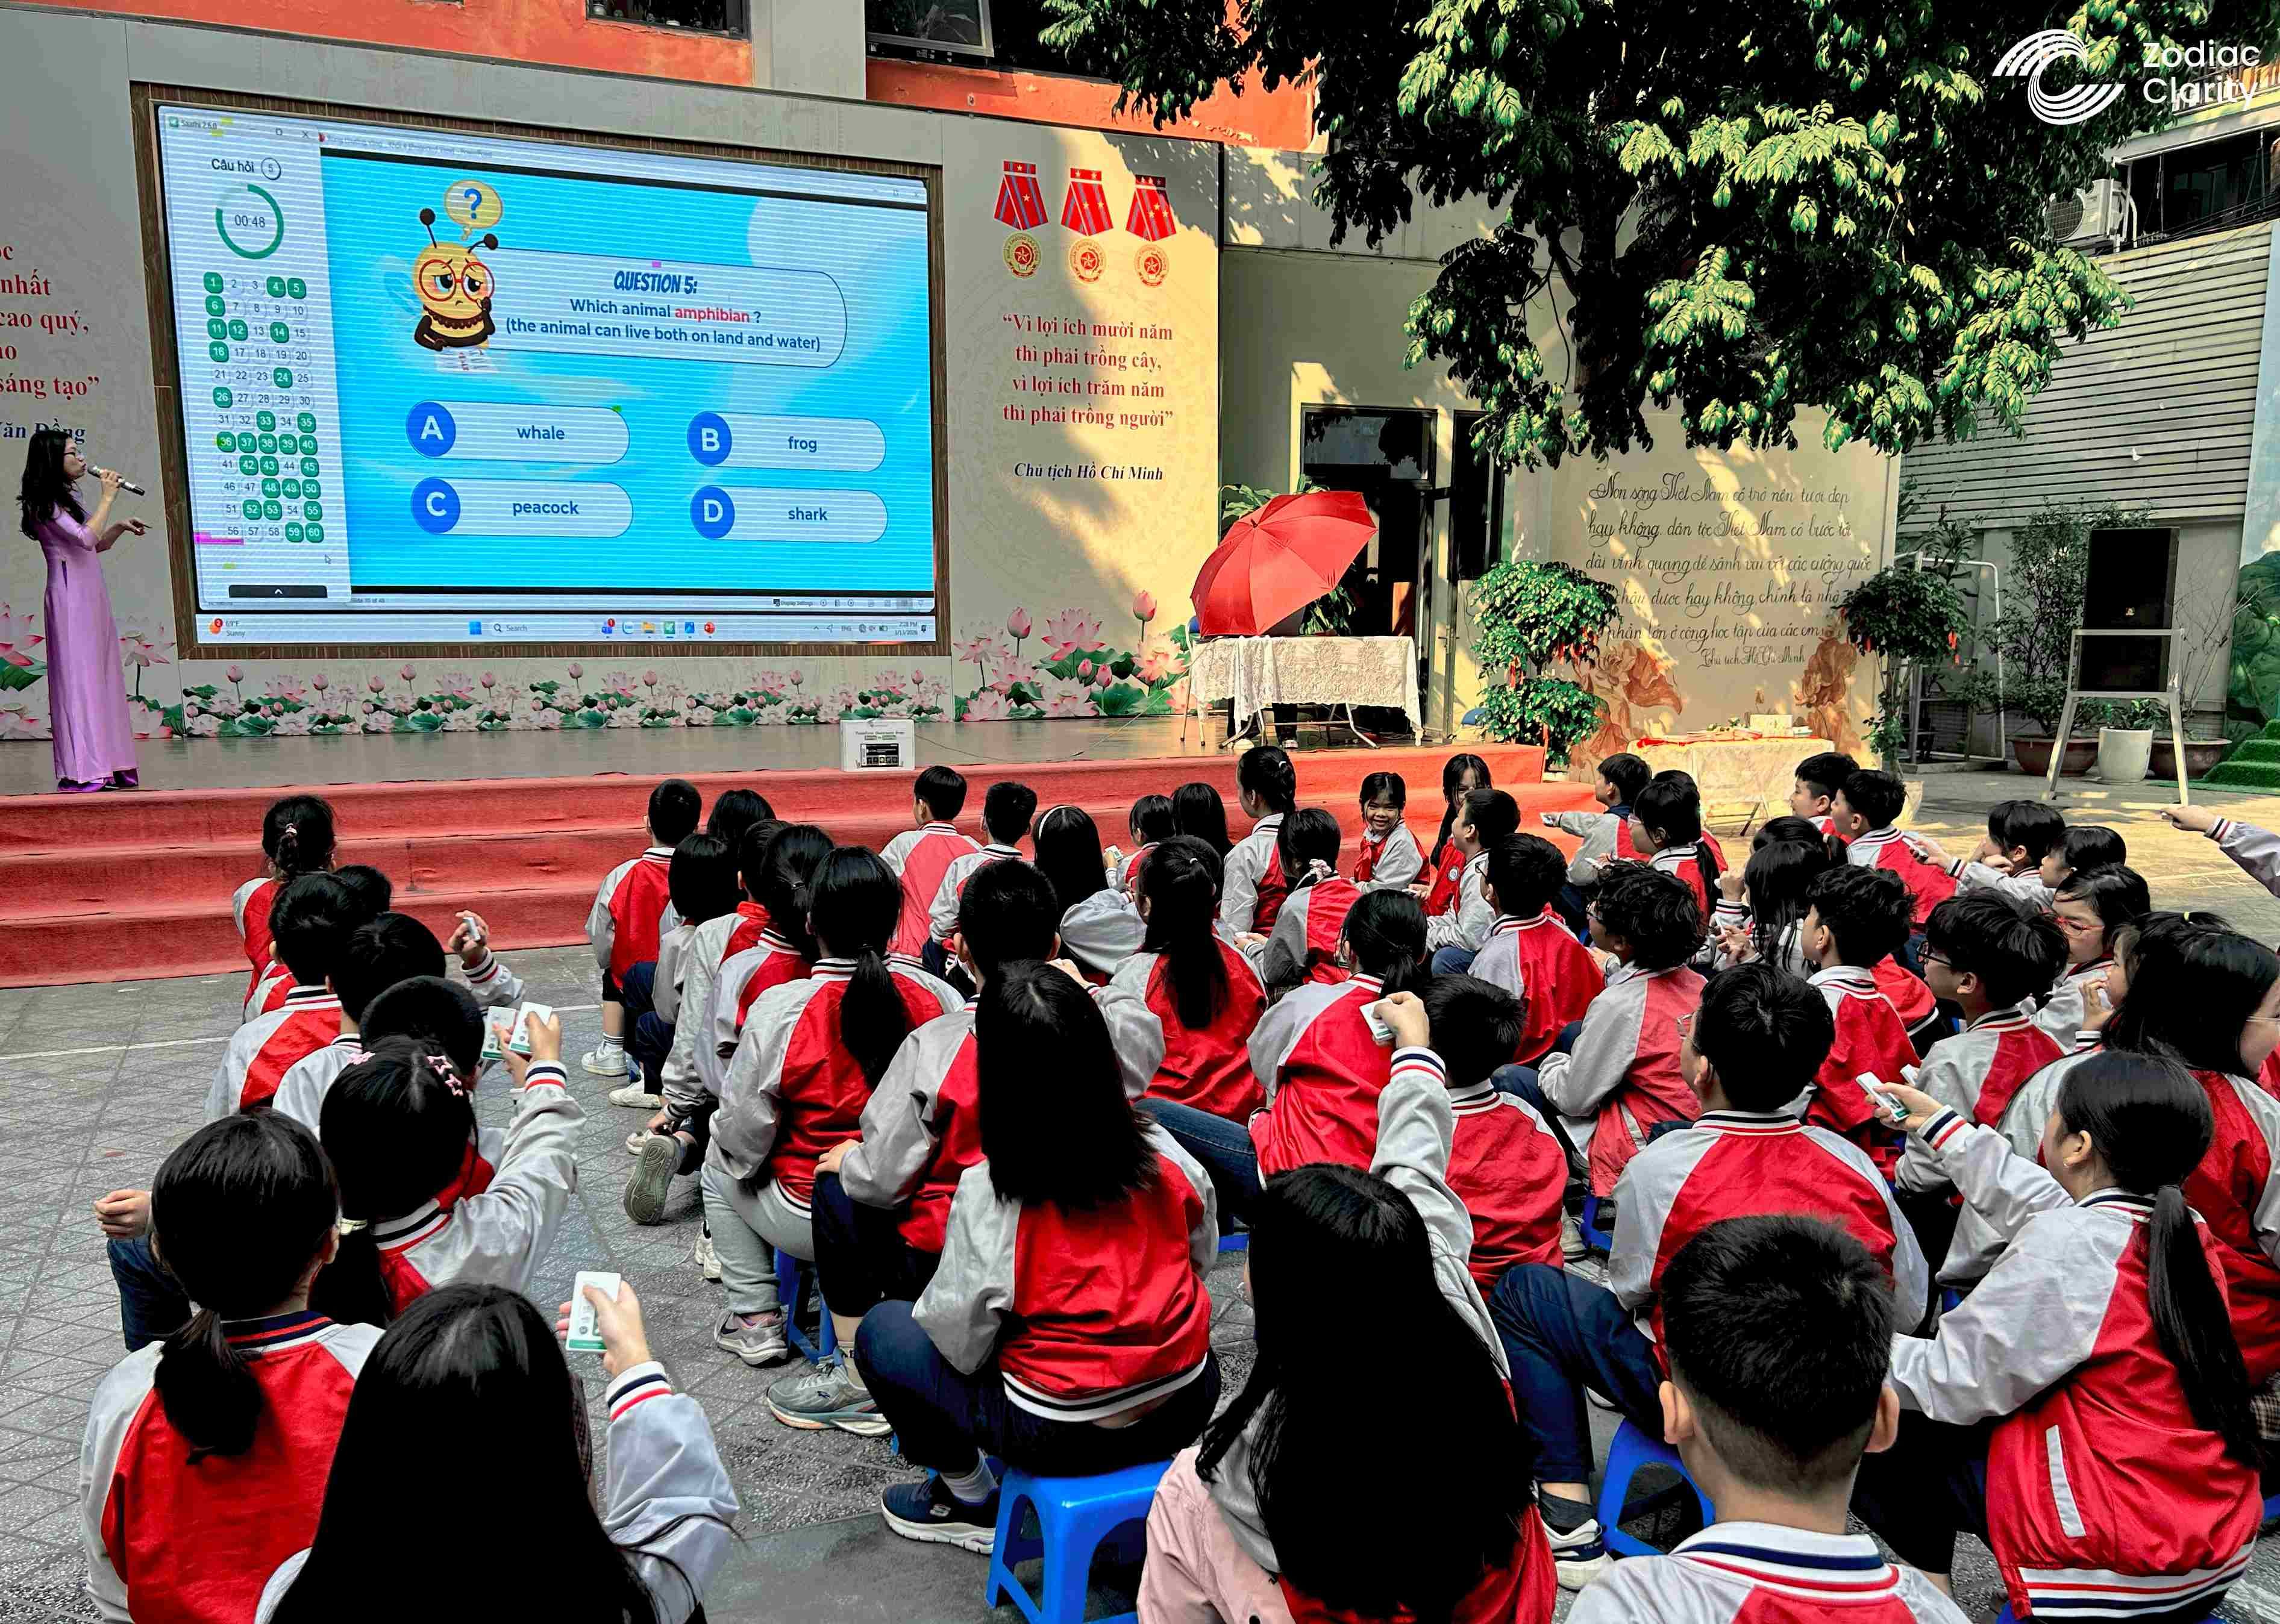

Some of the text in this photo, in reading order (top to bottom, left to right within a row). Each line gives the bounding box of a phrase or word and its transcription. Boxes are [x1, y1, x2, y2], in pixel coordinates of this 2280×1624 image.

[211, 158, 254, 173] Câu hỏi
[234, 214, 266, 228] 00:48
[0, 269, 52, 296] nhất
[211, 278, 216, 287] 1
[231, 280, 236, 288] 2
[293, 284, 299, 292] 5
[613, 270, 698, 295] QUESTION 5:
[212, 301, 218, 310] 6
[233, 302, 239, 311] 7
[254, 304, 260, 312] 8
[294, 307, 303, 315] 10
[569, 299, 762, 323] Which animal amphibian ?
[40, 310, 89, 336] quý,
[212, 324, 305, 337] 11 12 13 14 15
[1003, 313, 1173, 340] “Vì lợi ích mười năm
[506, 317, 820, 352] (the animal can live both on land and water)
[213, 348, 307, 360] 16 17 18 19 20
[1016, 345, 1162, 373] thì phải trồng cây,
[215, 370, 225, 378] 21
[236, 371, 246, 379] 22
[257, 372, 268, 380] 23
[277, 373, 289, 382] 24
[1012, 375, 1165, 398] vì lợi ích trăm năm
[217, 393, 228, 401] 26
[258, 395, 269, 403] 28
[299, 396, 310, 405] 30
[218, 415, 229, 423] 31
[239, 416, 250, 424] 32
[260, 416, 271, 425] 33
[301, 418, 312, 426] 35
[1003, 404, 1026, 420] thì
[1030, 405, 1066, 426] phải
[1071, 402, 1115, 429] trồng
[420, 415, 444, 440] A
[516, 425, 565, 440] whale
[242, 438, 252, 446] 37
[282, 440, 293, 448] 39
[701, 428, 720, 452] B
[788, 436, 818, 452] frog
[243, 461, 254, 469] 42
[1014, 461, 1163, 481] Chủ tịch Hồ Chí Minh
[224, 483, 235, 491] 46
[245, 483, 255, 491] 47
[226, 504, 236, 513] 51
[267, 505, 278, 514] 53
[287, 506, 298, 514] 54
[426, 491, 446, 517] C
[513, 501, 579, 516] peacock
[703, 499, 723, 522] D
[788, 507, 828, 521] shark
[248, 527, 258, 536] 57
[289, 528, 300, 536] 59
[308, 528, 320, 537] 60
[506, 624, 528, 632] Search
